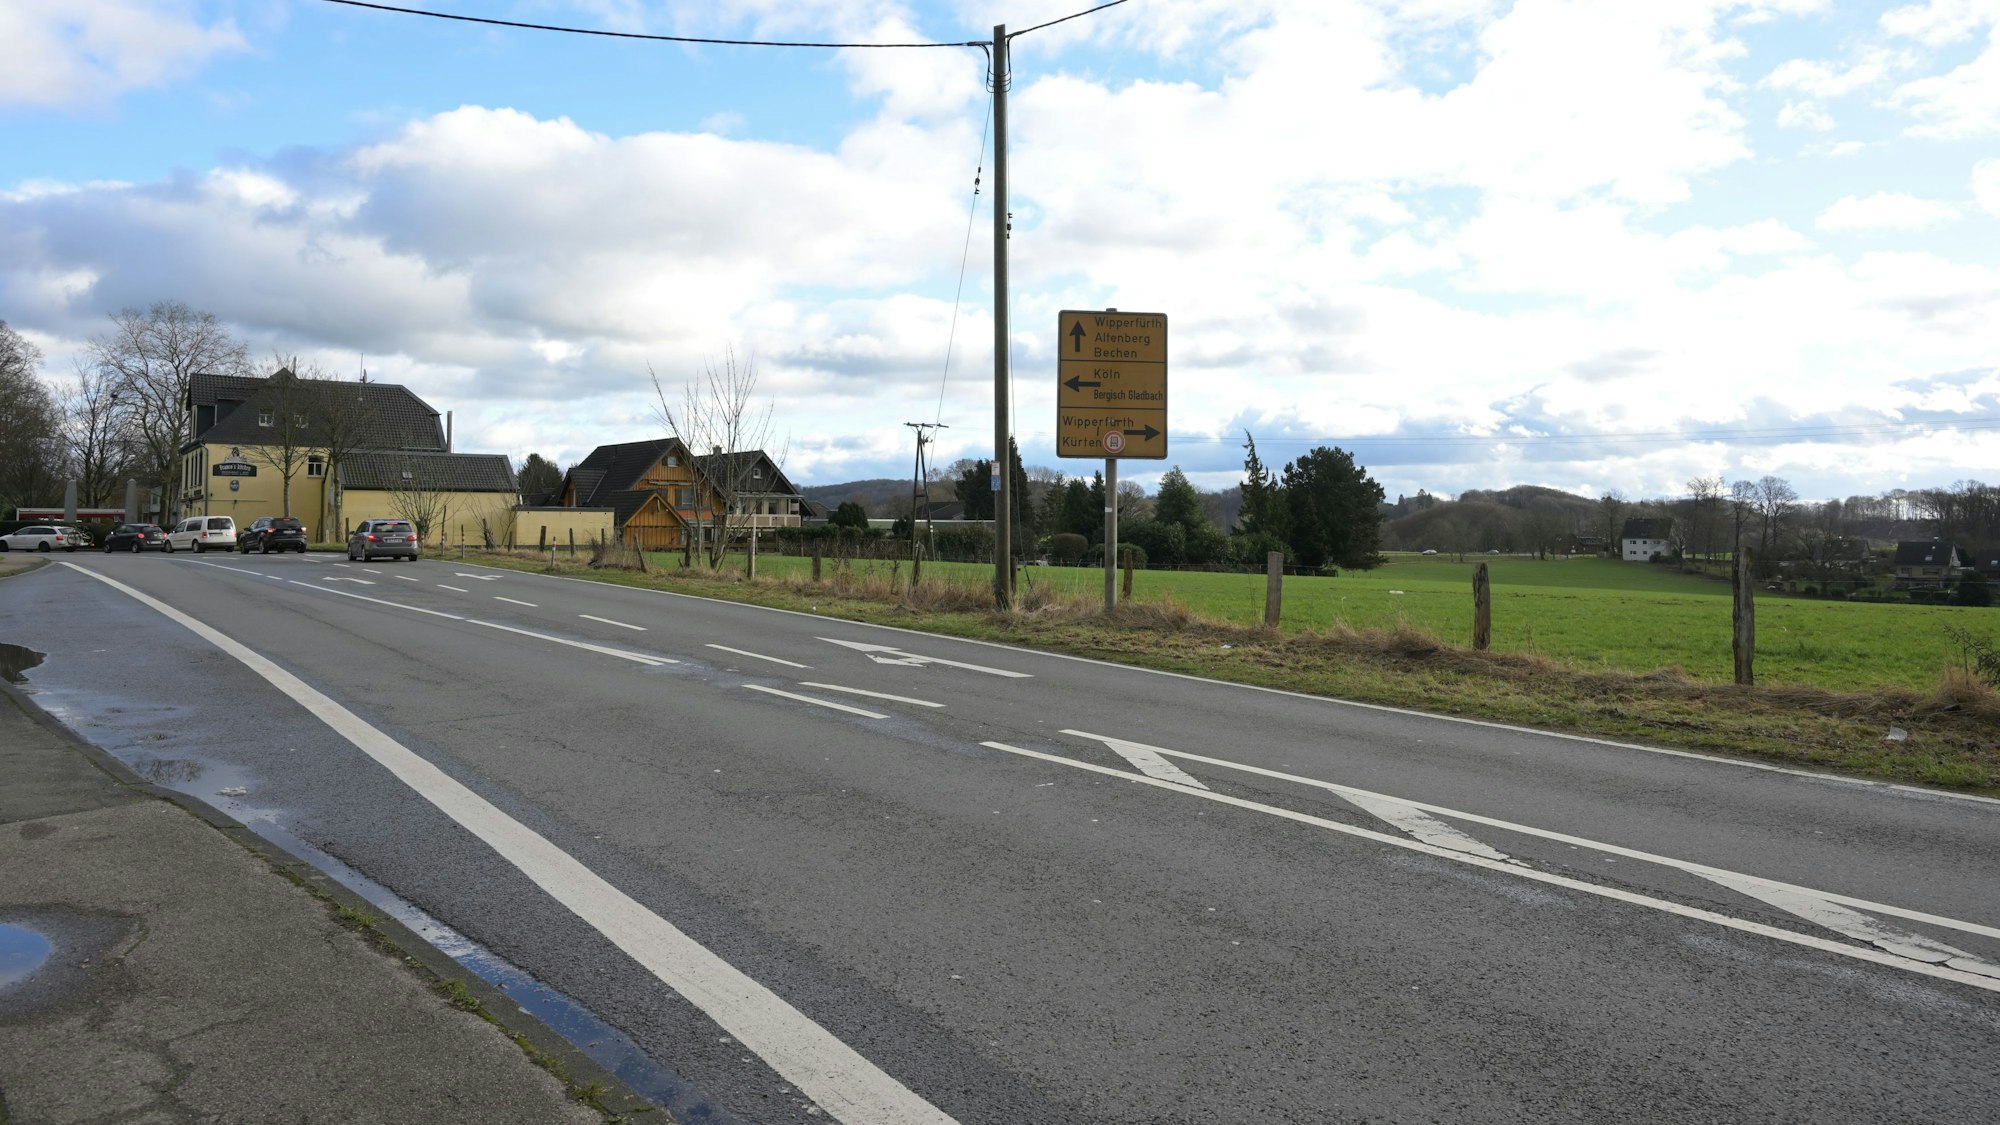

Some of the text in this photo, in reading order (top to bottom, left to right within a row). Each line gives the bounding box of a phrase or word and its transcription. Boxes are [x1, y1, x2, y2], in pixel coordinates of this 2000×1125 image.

[1094, 316, 1162, 329] Wipperfürth
[1094, 332, 1150, 346] Altenberg
[1094, 347, 1137, 358] Bechen
[1094, 368, 1120, 379] Köln
[1093, 389, 1163, 402] Bergisch Gladbach
[1062, 437, 1102, 448] Kürten
